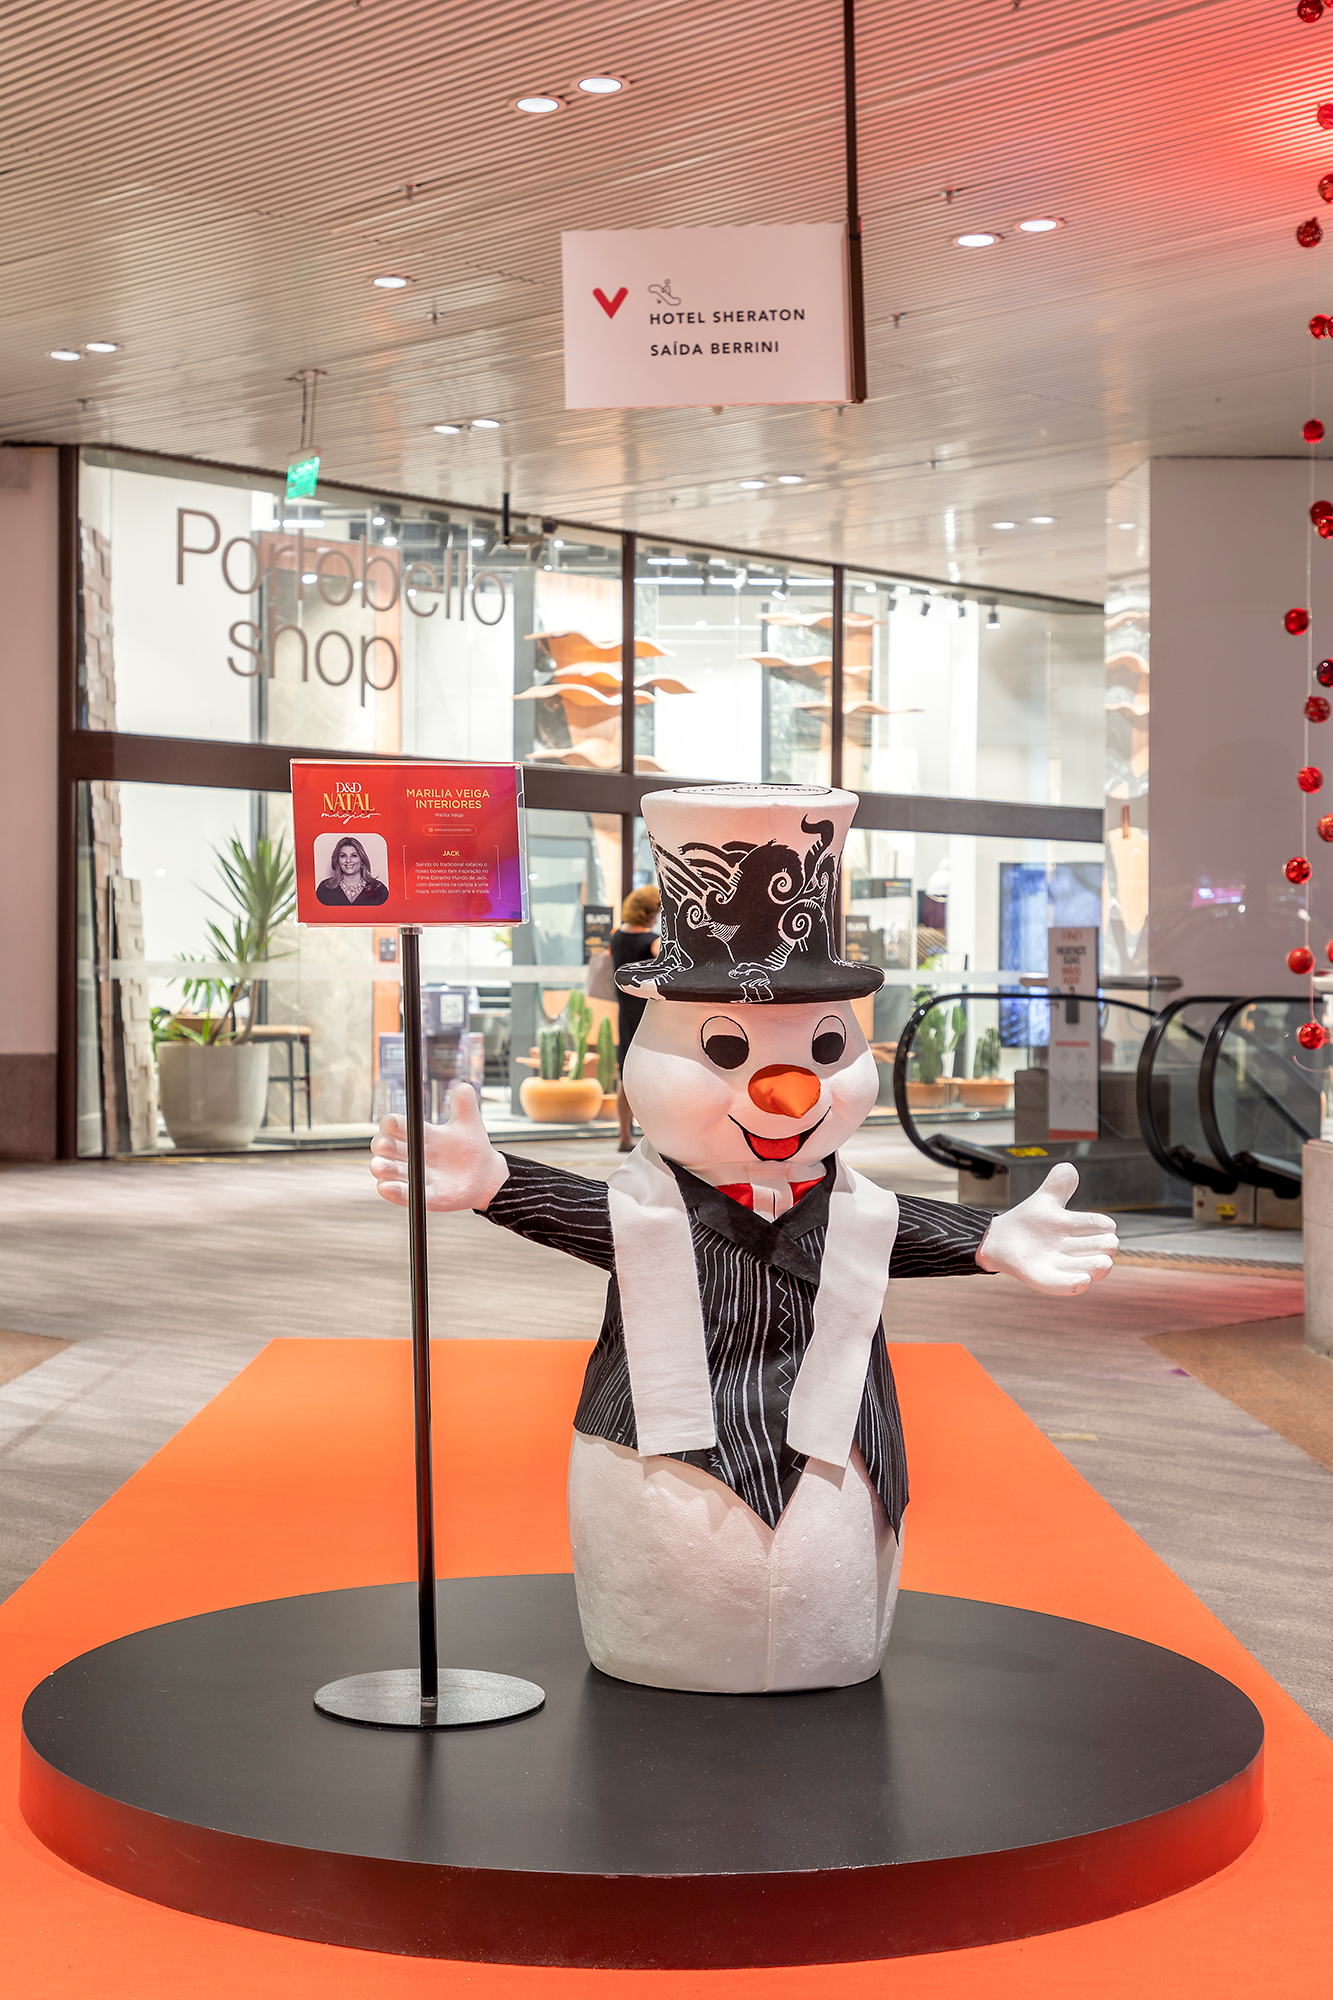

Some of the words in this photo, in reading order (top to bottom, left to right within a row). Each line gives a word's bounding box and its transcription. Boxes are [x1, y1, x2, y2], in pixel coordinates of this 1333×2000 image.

[650, 312, 706, 325] HOTEL
[713, 309, 806, 323] SHERATON
[650, 341, 703, 356] SAÍDA
[710, 341, 779, 354] BERRINI
[177, 507, 505, 626] Portobello
[227, 603, 398, 707] shop
[336, 782, 362, 793] D&D
[406, 788, 453, 798] MARILIA
[455, 788, 490, 798] VEIGA
[323, 793, 376, 812] NATAL
[415, 799, 482, 809] INTERIORES
[321, 811, 381, 824] mágico
